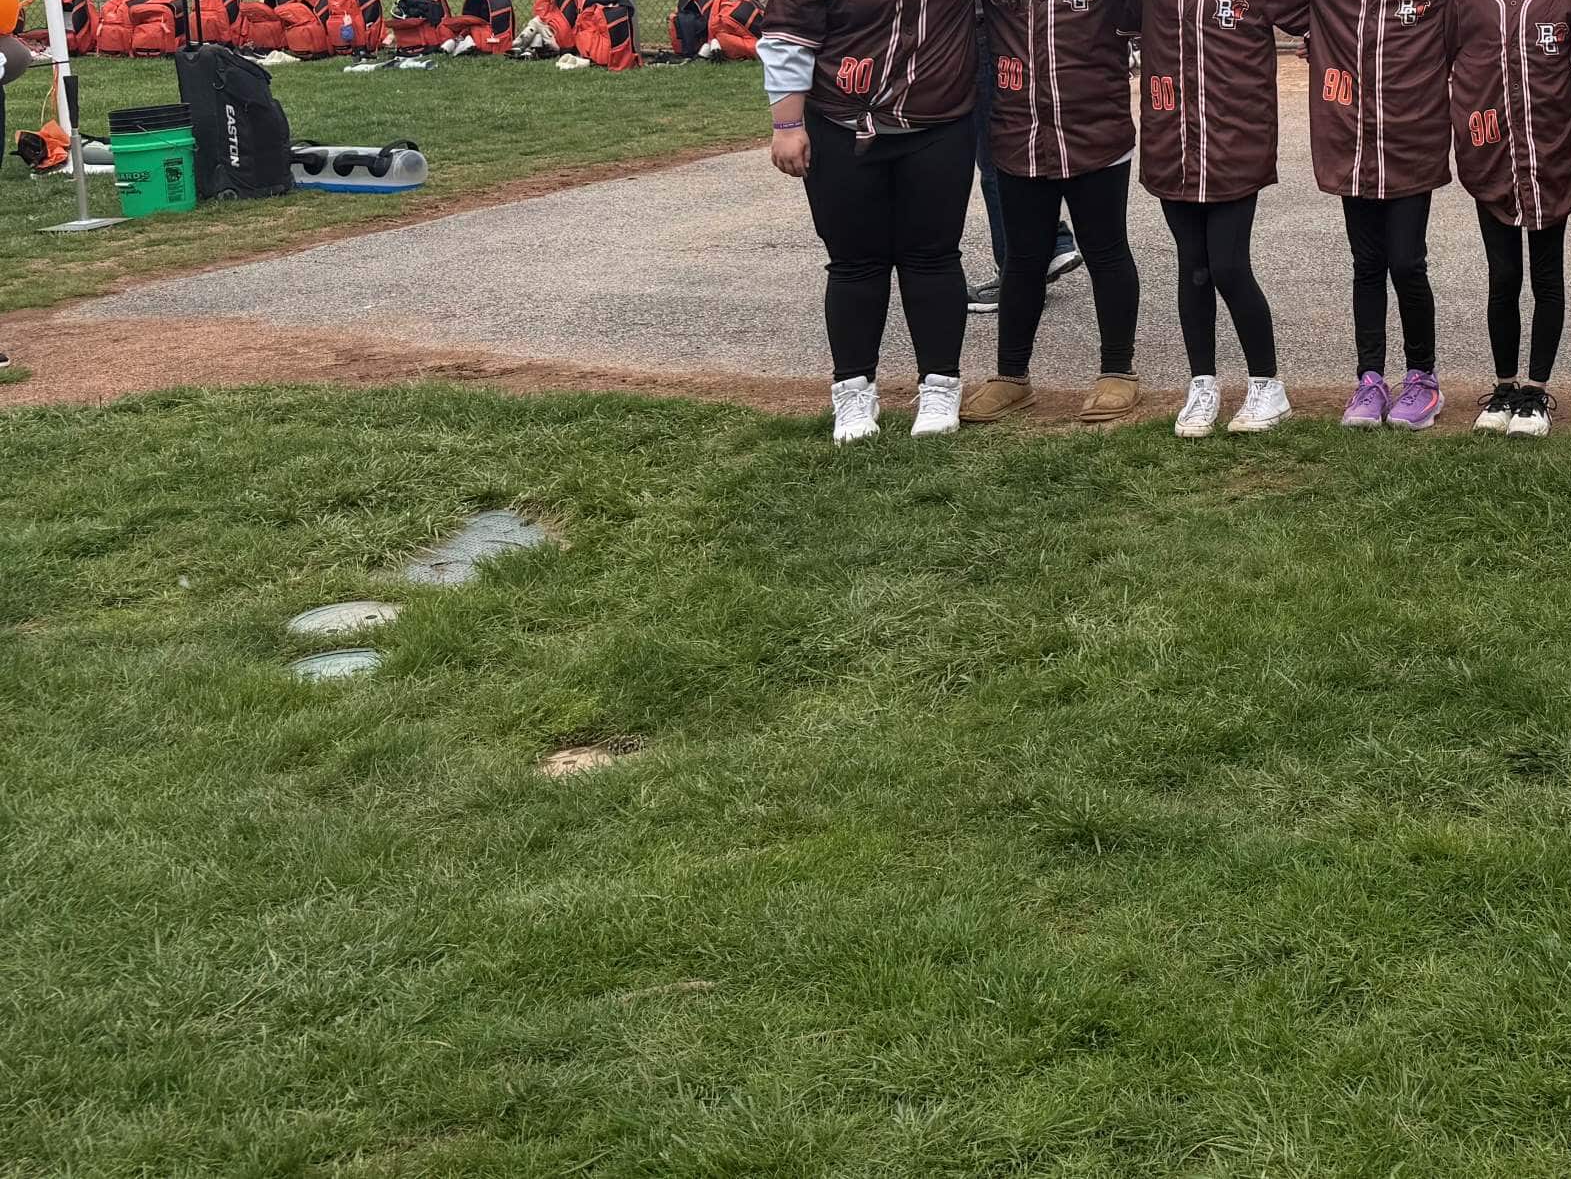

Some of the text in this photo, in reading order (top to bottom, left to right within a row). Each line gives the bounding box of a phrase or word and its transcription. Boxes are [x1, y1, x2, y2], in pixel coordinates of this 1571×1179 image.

[837, 57, 873, 93] 90
[1151, 76, 1174, 110] 90
[1323, 68, 1352, 105] 90
[226, 104, 240, 167] EASTON
[1469, 109, 1500, 146] 90
